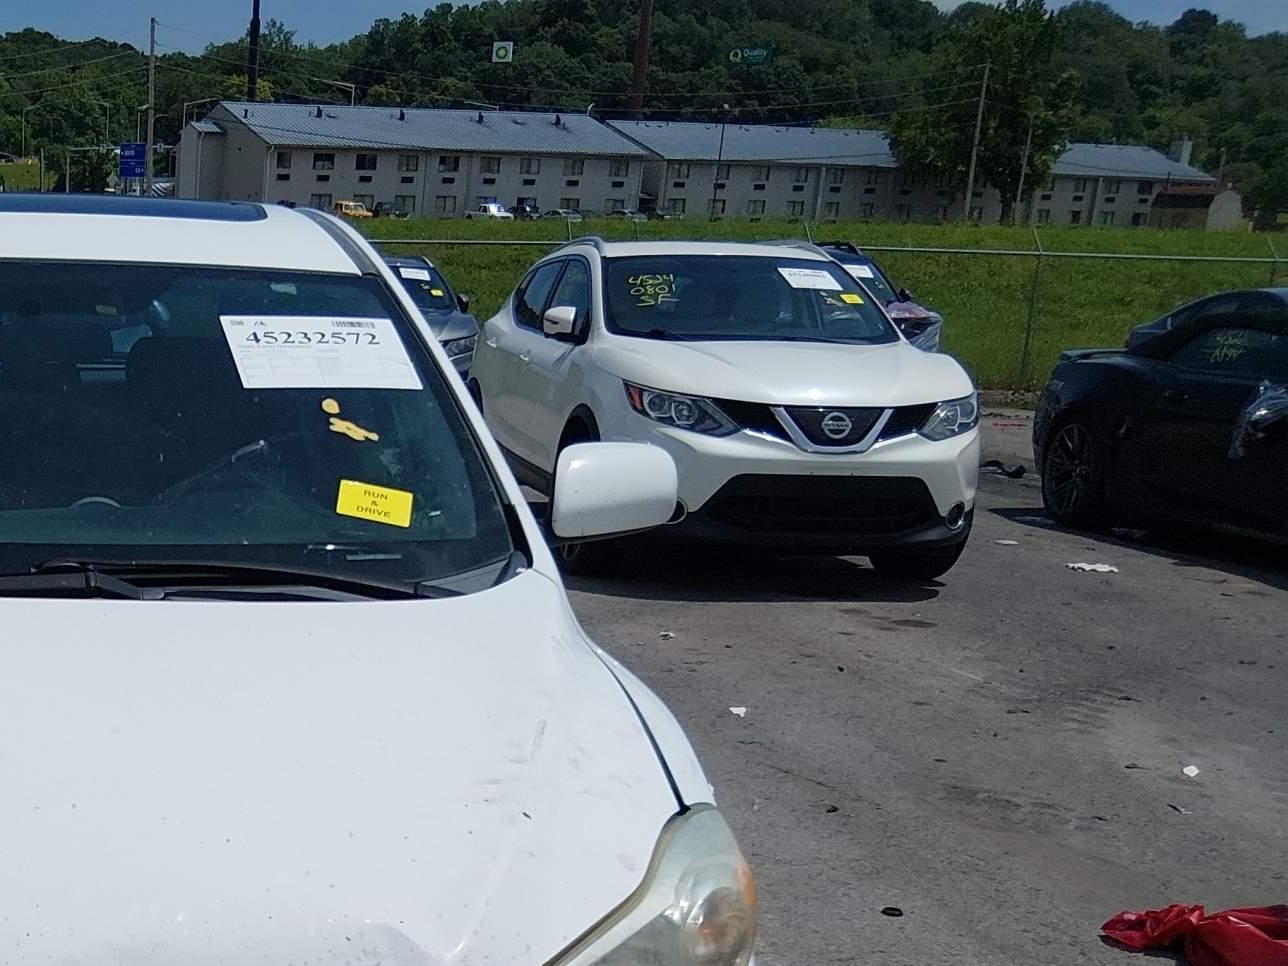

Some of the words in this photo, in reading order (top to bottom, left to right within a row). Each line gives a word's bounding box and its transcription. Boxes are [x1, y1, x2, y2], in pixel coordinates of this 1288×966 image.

[245, 331, 380, 346] 45232572
[363, 489, 388, 500] RUN
[356, 505, 391, 519] DRIVE
